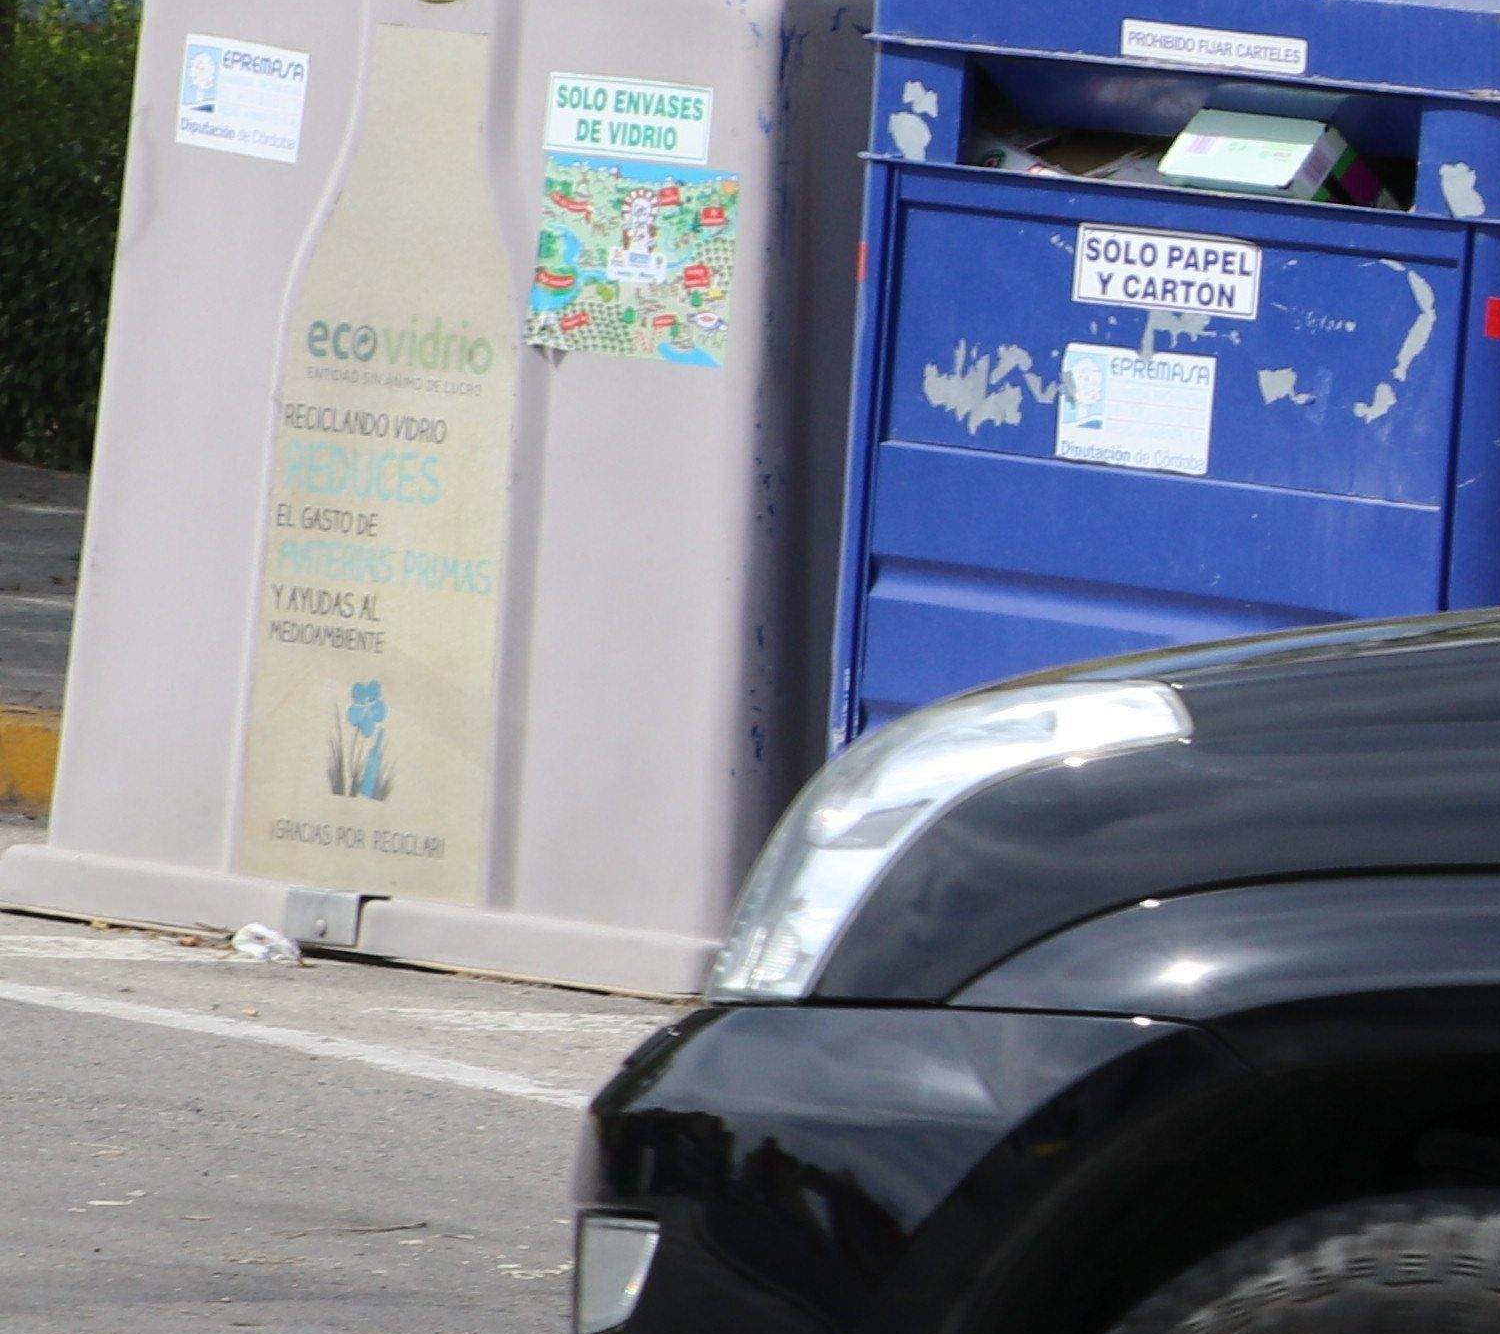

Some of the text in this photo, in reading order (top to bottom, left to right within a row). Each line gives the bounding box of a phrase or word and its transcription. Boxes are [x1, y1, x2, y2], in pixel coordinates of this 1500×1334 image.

[1128, 31, 1195, 53] PROHIBIDO
[556, 84, 705, 122] SOLO ENVASES
[575, 117, 677, 151] DE VIDRIO
[1168, 245, 1252, 276] PAPEL
[1098, 272, 1114, 296] Y
[285, 403, 448, 444] RECICLANDO VIDRIO
[276, 503, 293, 527] EL
[301, 506, 354, 534] GASTO
[285, 585, 354, 618] AYUDAS
